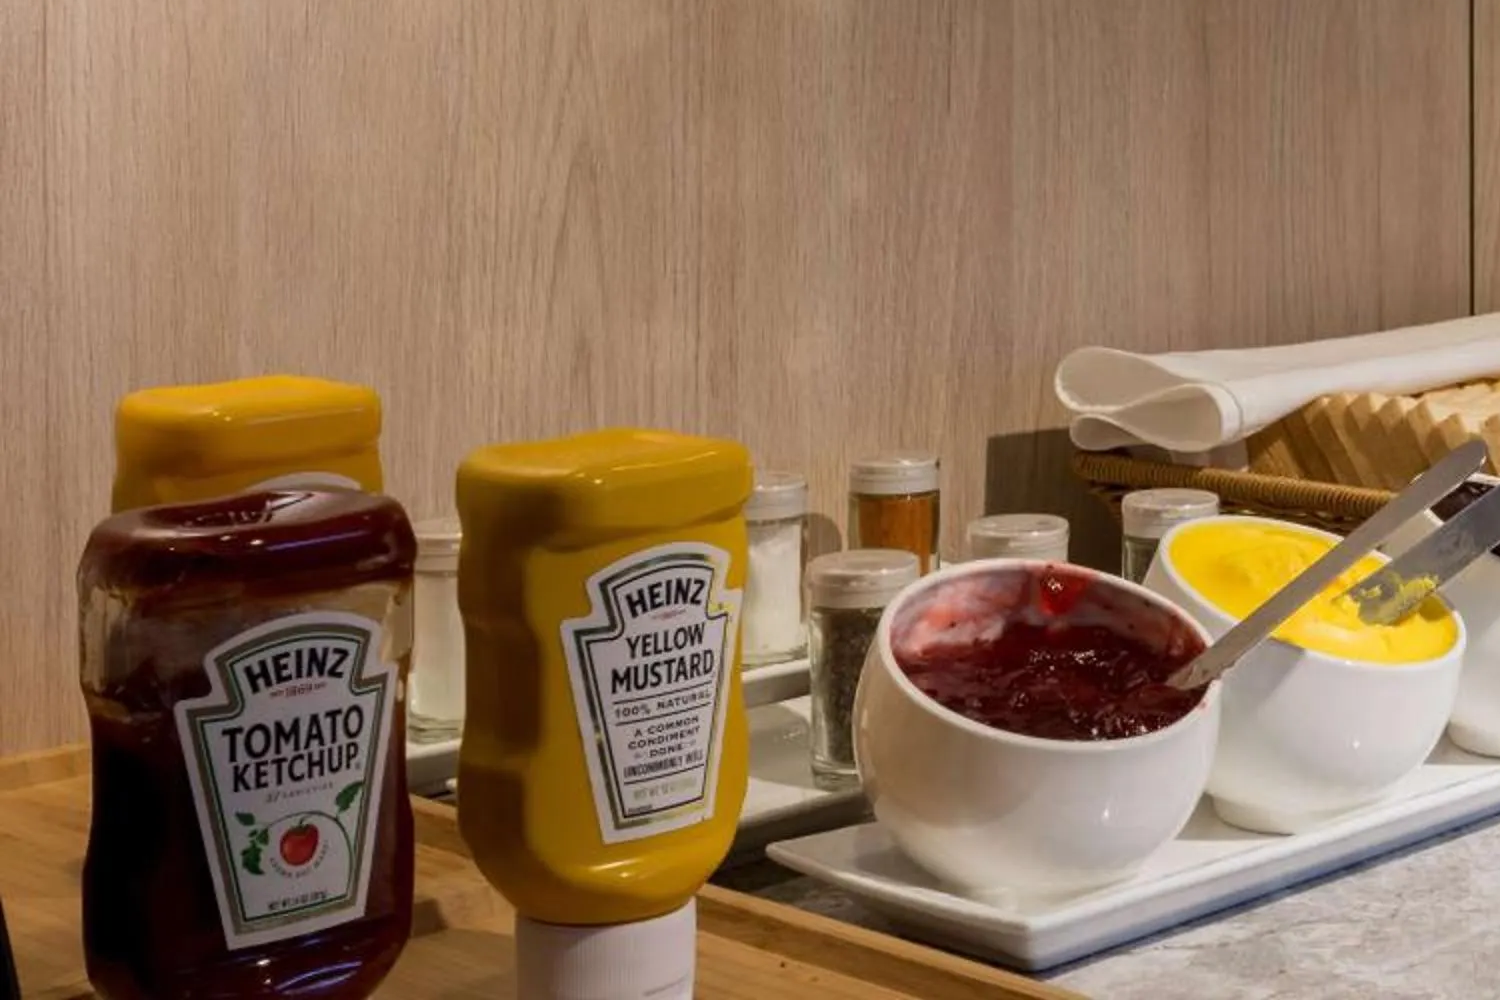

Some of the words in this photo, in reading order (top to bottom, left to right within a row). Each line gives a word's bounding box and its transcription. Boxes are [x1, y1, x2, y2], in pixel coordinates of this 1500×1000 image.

[625, 578, 705, 619] HEINZ
[626, 621, 705, 660] YELLOW
[244, 647, 349, 694] HEINZ
[611, 649, 715, 695] MUSTARD
[615, 703, 651, 719] 100%
[656, 690, 712, 710] NATURAL
[221, 704, 364, 763] TOMATO
[627, 725, 701, 750] CONDIMENT
[634, 728, 642, 738] A
[647, 716, 699, 735] COMMON
[232, 742, 359, 793] KETCHUP
[649, 743, 683, 758] DONE
